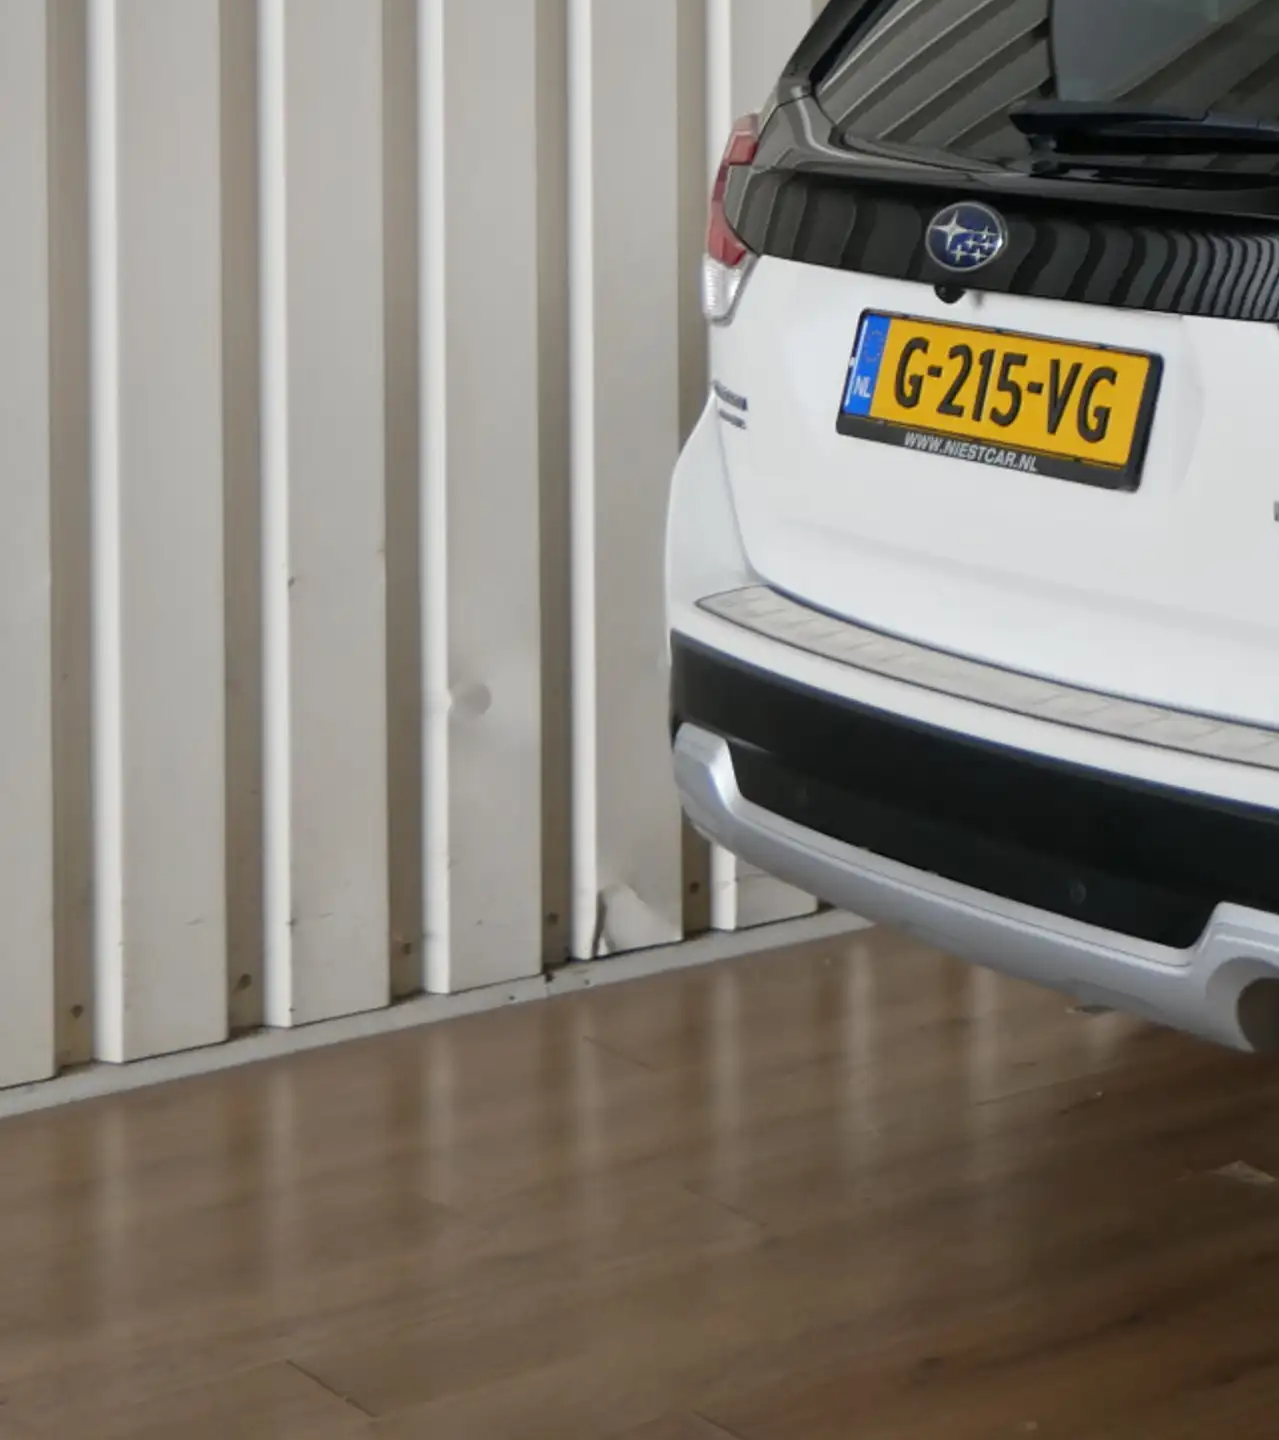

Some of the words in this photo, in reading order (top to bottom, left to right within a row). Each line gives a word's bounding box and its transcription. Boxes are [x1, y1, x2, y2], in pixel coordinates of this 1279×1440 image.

[853, 374, 872, 398] NL
[893, 336, 1118, 444] G-215-VG
[903, 431, 1038, 473] WWW.NIESTCAR.NL
